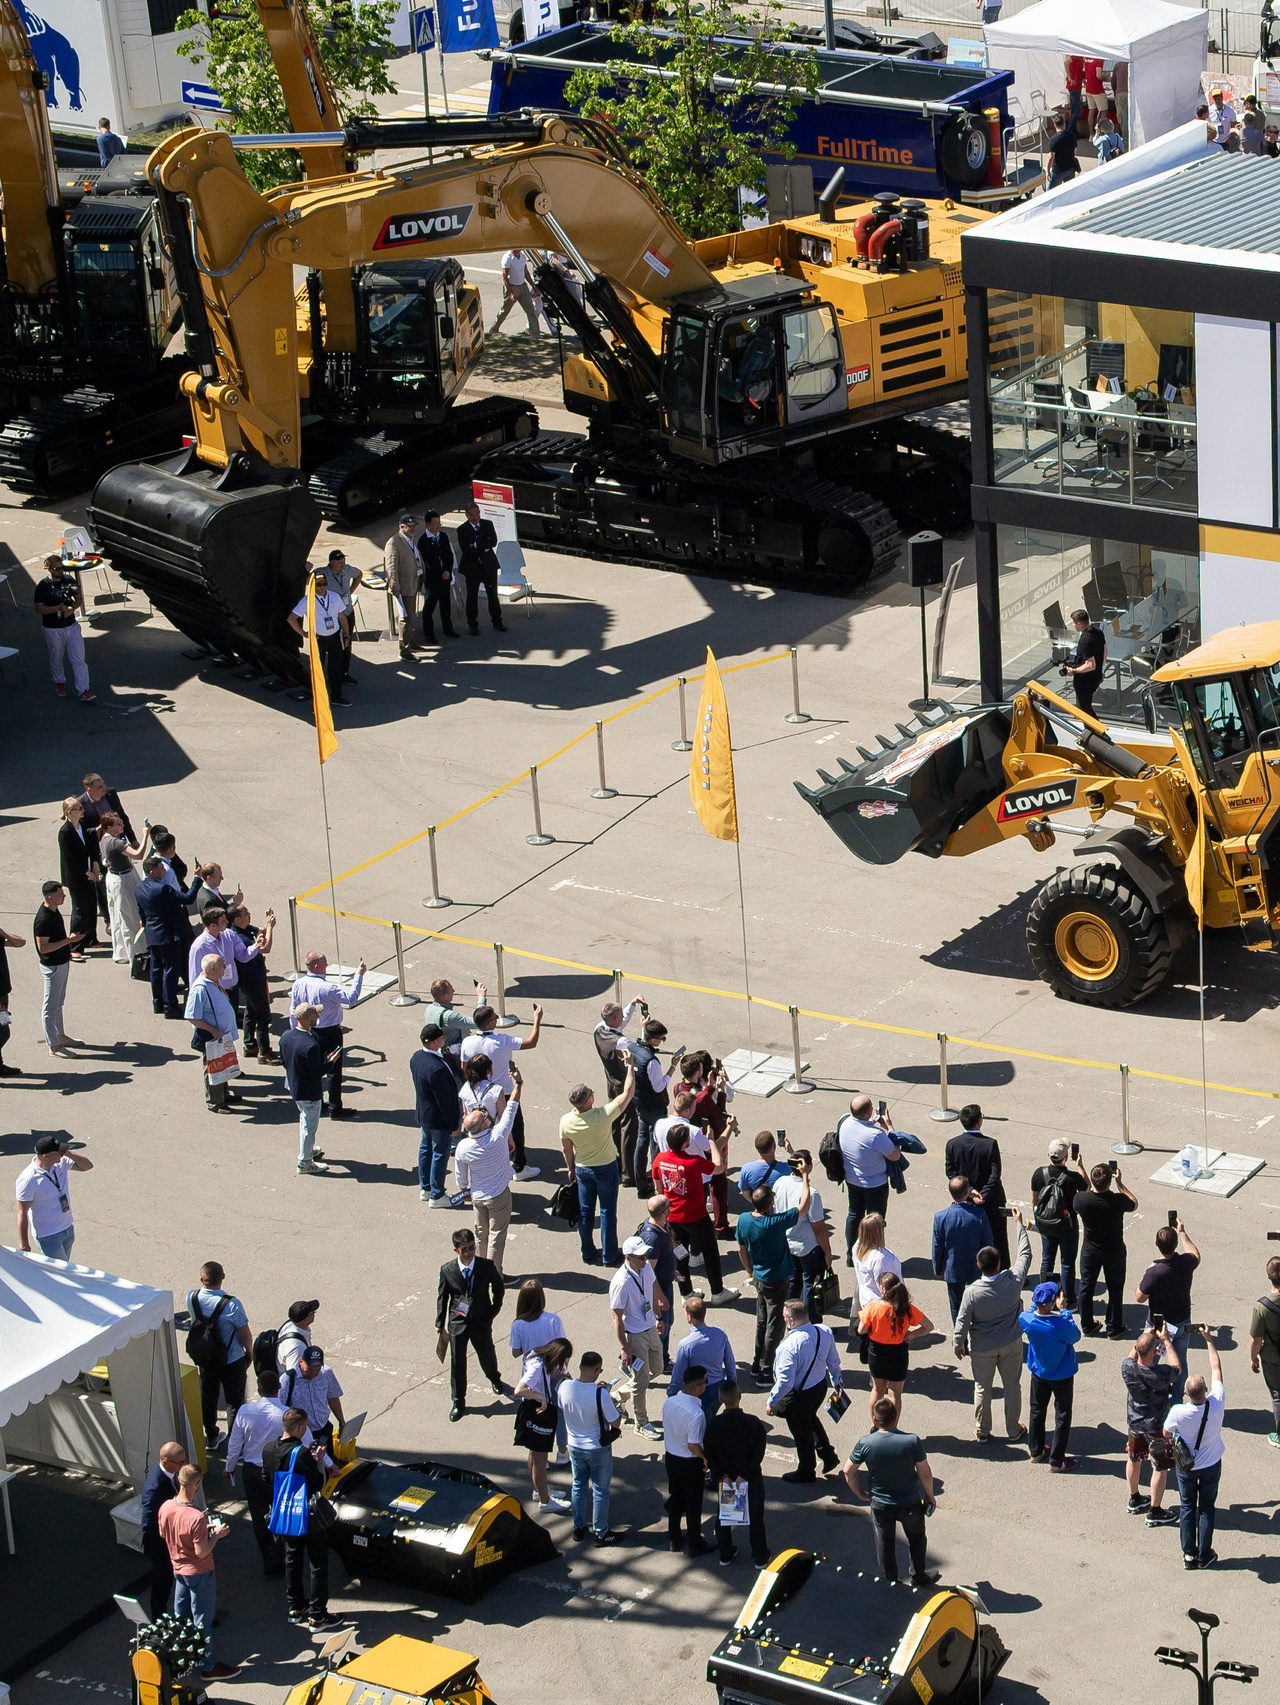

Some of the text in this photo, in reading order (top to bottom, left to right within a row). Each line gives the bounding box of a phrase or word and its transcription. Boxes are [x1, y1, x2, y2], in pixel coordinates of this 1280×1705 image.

[817, 136, 913, 165] FullTime
[389, 215, 463, 240] LOVOL
[1005, 788, 1072, 814] LOVOL
[1228, 796, 1264, 806] WEICHAI
